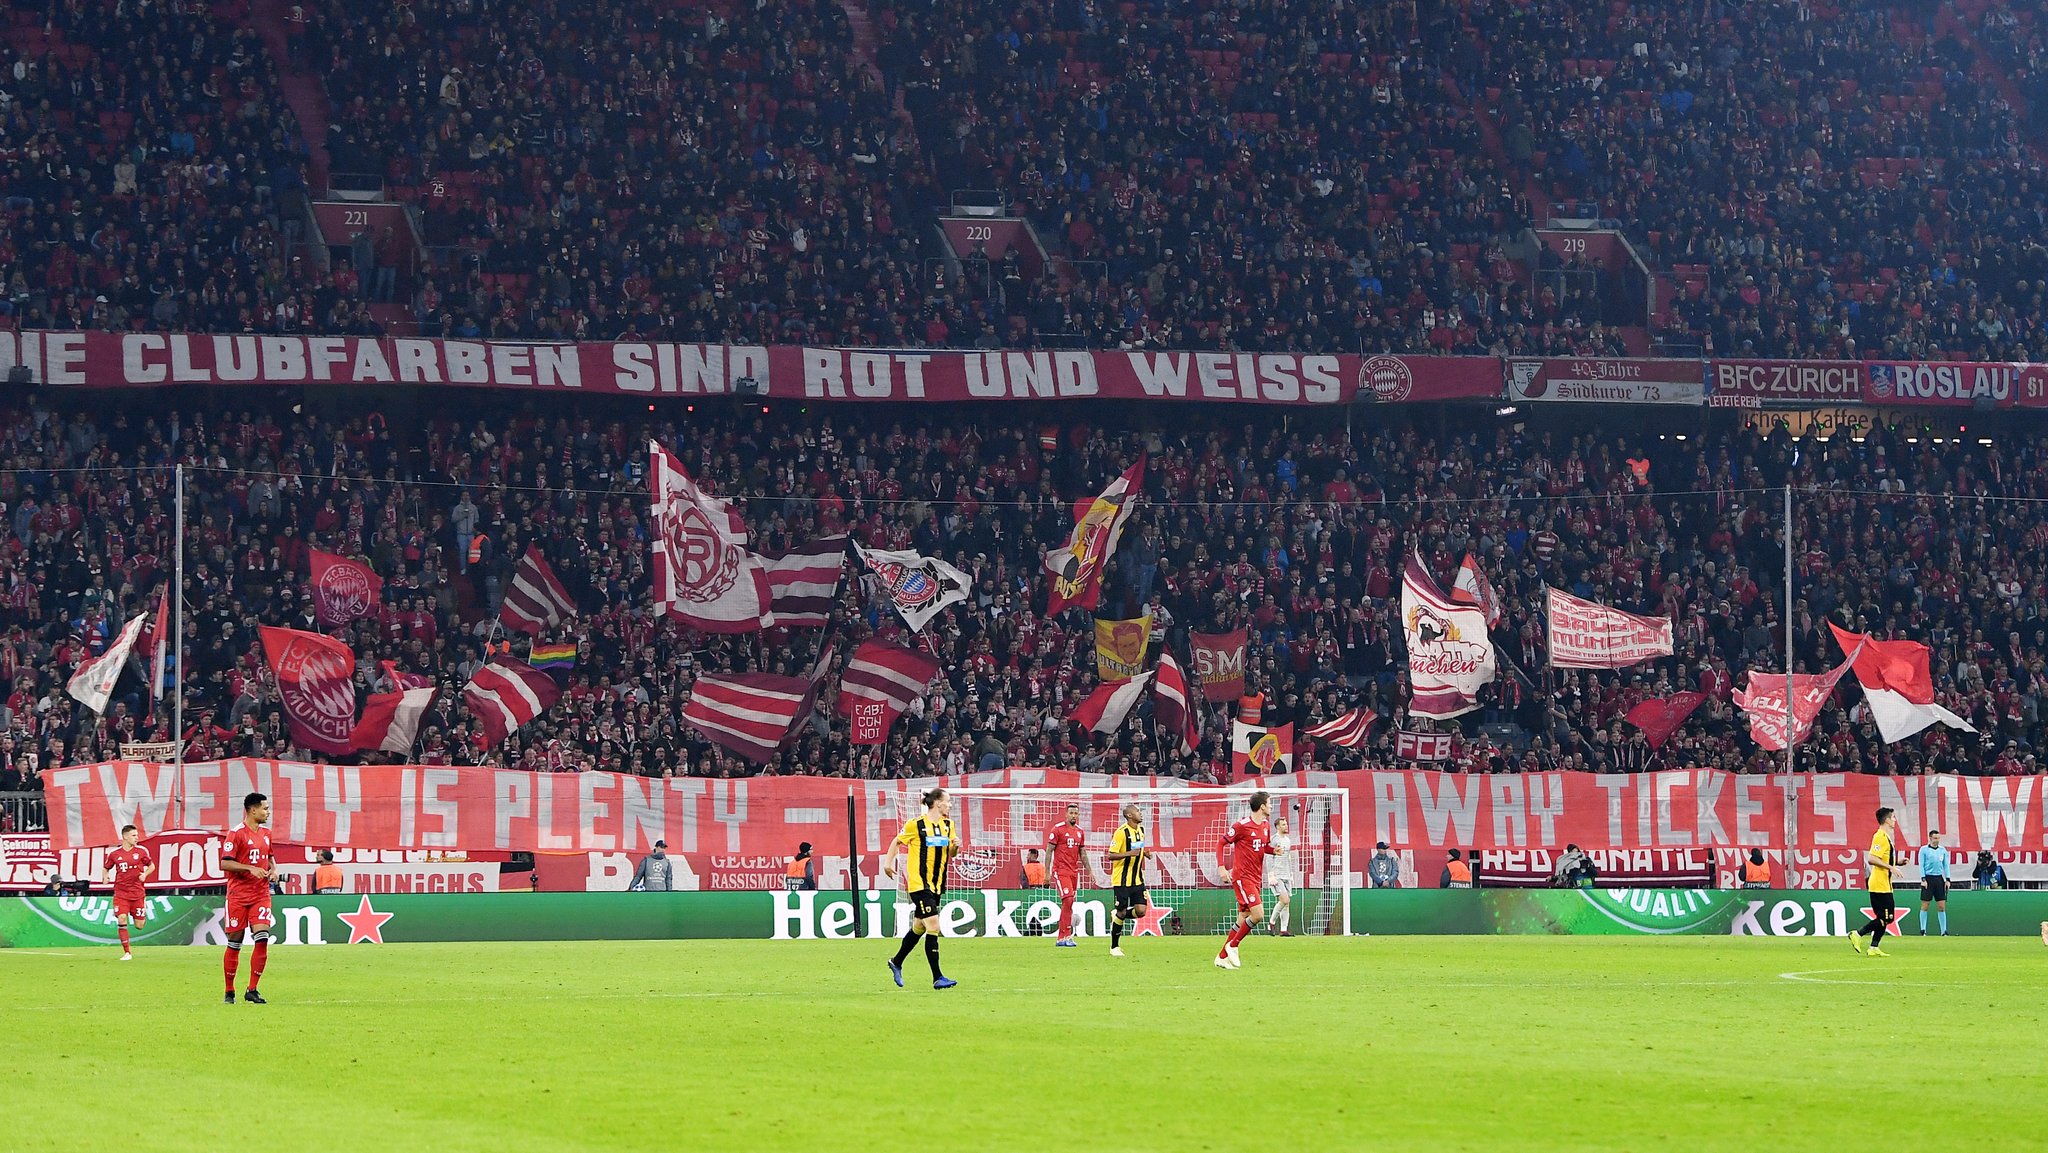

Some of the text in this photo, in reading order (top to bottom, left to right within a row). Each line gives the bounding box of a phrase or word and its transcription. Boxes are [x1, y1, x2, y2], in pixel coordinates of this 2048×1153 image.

[432, 183, 444, 194] 25
[344, 211, 368, 225] 221
[966, 226, 991, 240] 220
[1563, 238, 1586, 252] 219
[121, 333, 582, 387] CLUBFARBEN
[613, 343, 770, 396] SIND
[803, 347, 931, 398] ROT
[964, 351, 1099, 397] UND
[1126, 352, 1341, 402] WEISS
[1718, 364, 1859, 393] BFC ZÜRICH
[1894, 363, 2010, 400] RÖSLAU
[1557, 382, 1633, 400] Südkurve
[1810, 409, 1869, 430] Kaffee
[1195, 645, 1244, 676] SM
[858, 715, 882, 728] CON
[859, 728, 880, 740] NOI
[1396, 732, 1452, 761] FCB
[52, 759, 362, 848] TWENTY
[399, 769, 459, 847] IS
[494, 770, 749, 853] PLENTY
[1372, 771, 1564, 847] AWAY
[1595, 769, 1848, 848] TICKETS
[3, 840, 40, 851] Sektion
[158, 837, 225, 881] rot
[711, 871, 786, 889] RASSISMUS
[135, 907, 146, 917] 32
[258, 906, 272, 920] 22
